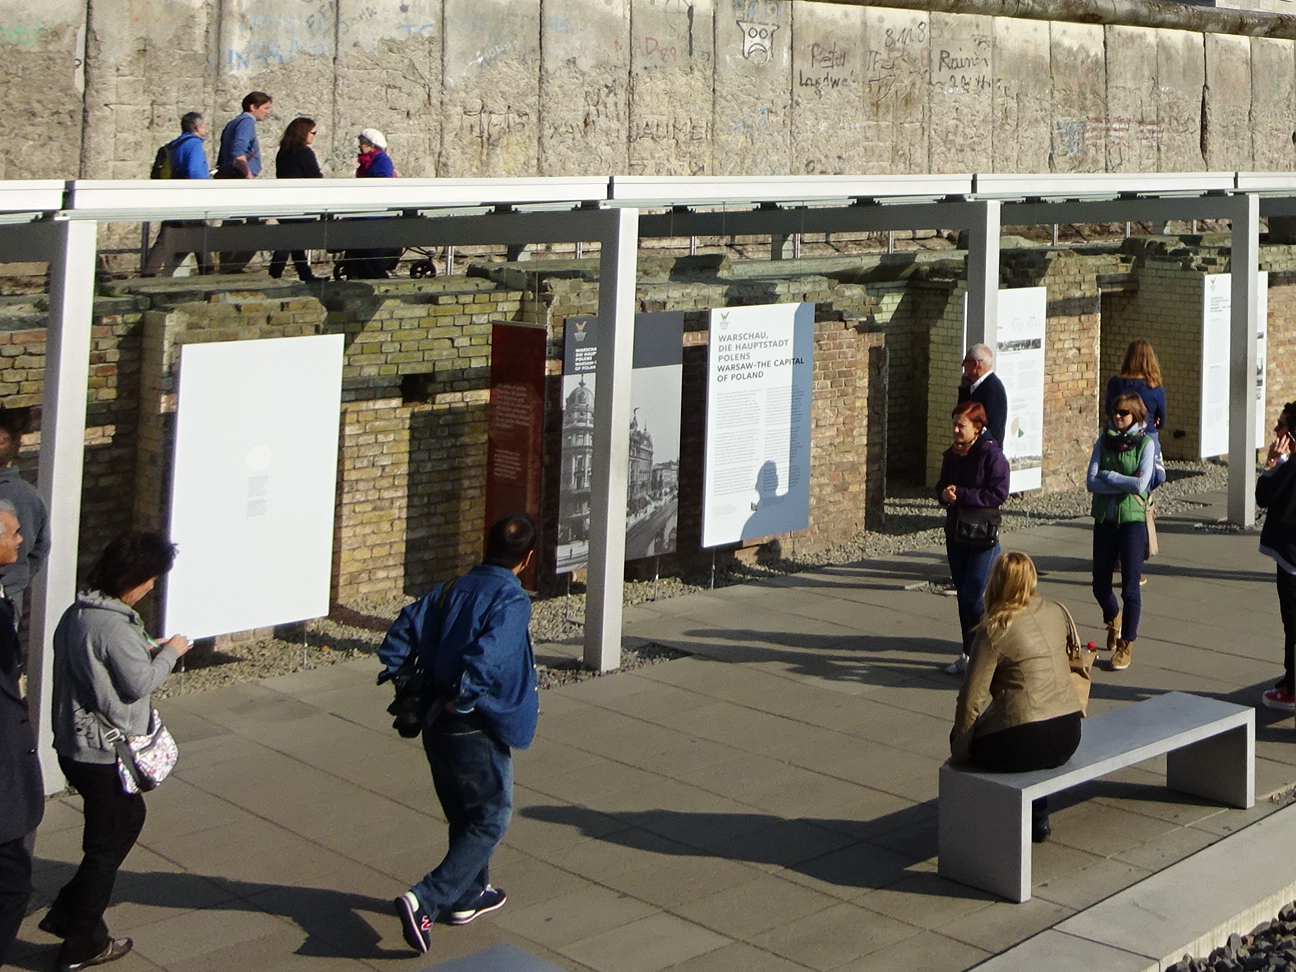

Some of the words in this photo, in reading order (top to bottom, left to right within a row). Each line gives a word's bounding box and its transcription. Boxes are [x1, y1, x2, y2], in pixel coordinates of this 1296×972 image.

[718, 331, 769, 343] WARSCHAU,
[718, 344, 733, 353] DIE
[735, 339, 789, 351] HAUPTSTADT
[718, 352, 751, 362] POLENS
[773, 357, 804, 367] CAPITAL
[717, 374, 728, 383] OF
[731, 370, 764, 381] POLAND
